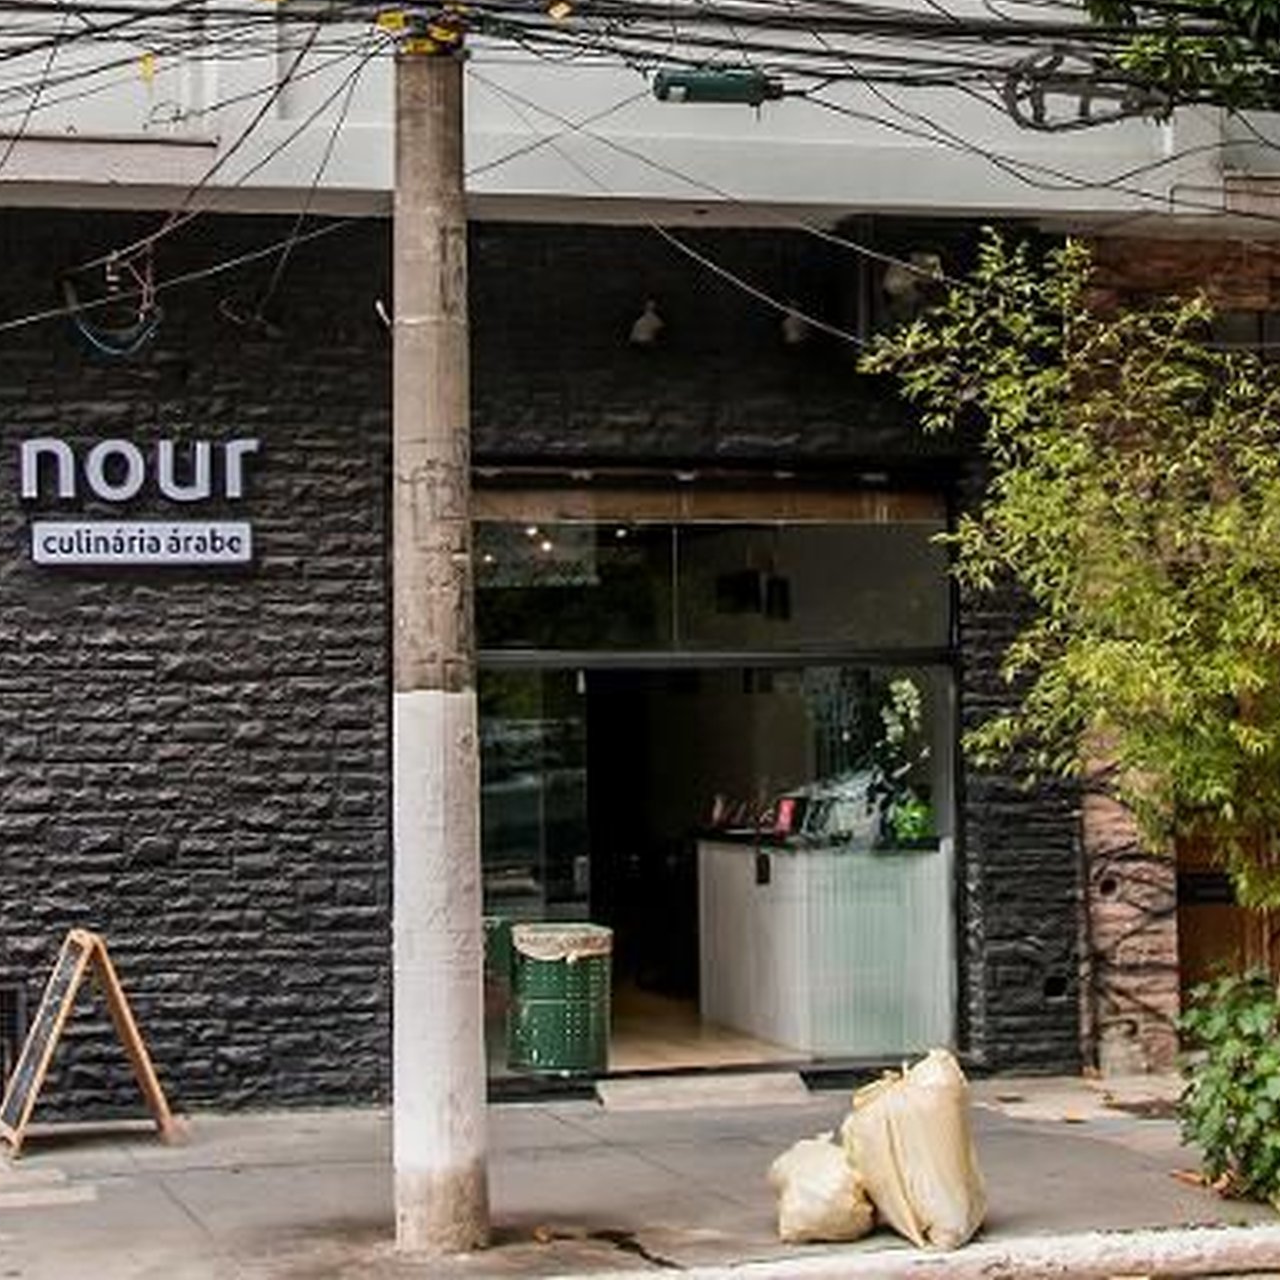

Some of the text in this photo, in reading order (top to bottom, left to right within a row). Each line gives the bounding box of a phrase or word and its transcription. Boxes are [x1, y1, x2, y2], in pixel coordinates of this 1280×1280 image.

[21, 438, 259, 501] nour
[42, 528, 241, 555] culinária árabe
